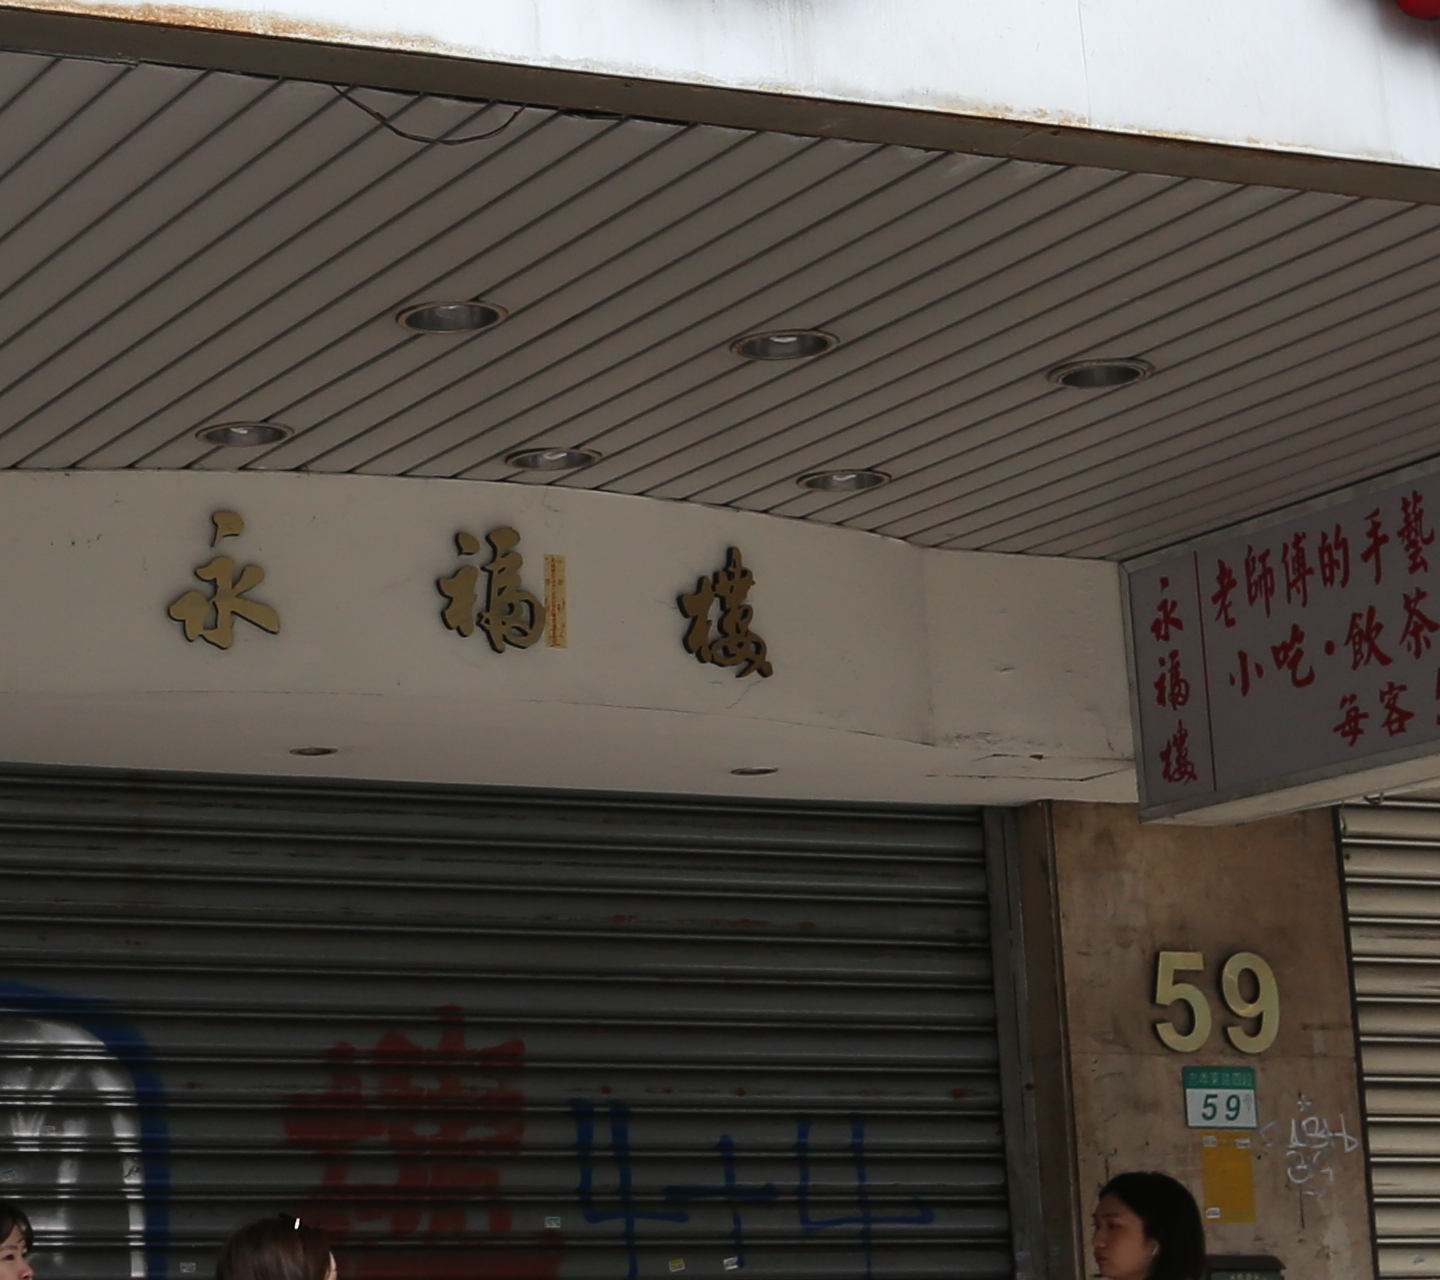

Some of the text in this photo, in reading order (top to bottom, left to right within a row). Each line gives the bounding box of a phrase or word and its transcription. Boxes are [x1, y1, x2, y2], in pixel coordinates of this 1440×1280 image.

[167, 510, 774, 680] 永福樓
[1150, 575, 1198, 788] 永福樓
[1155, 951, 1280, 1054] 59
[1201, 1093, 1241, 1121] 59
